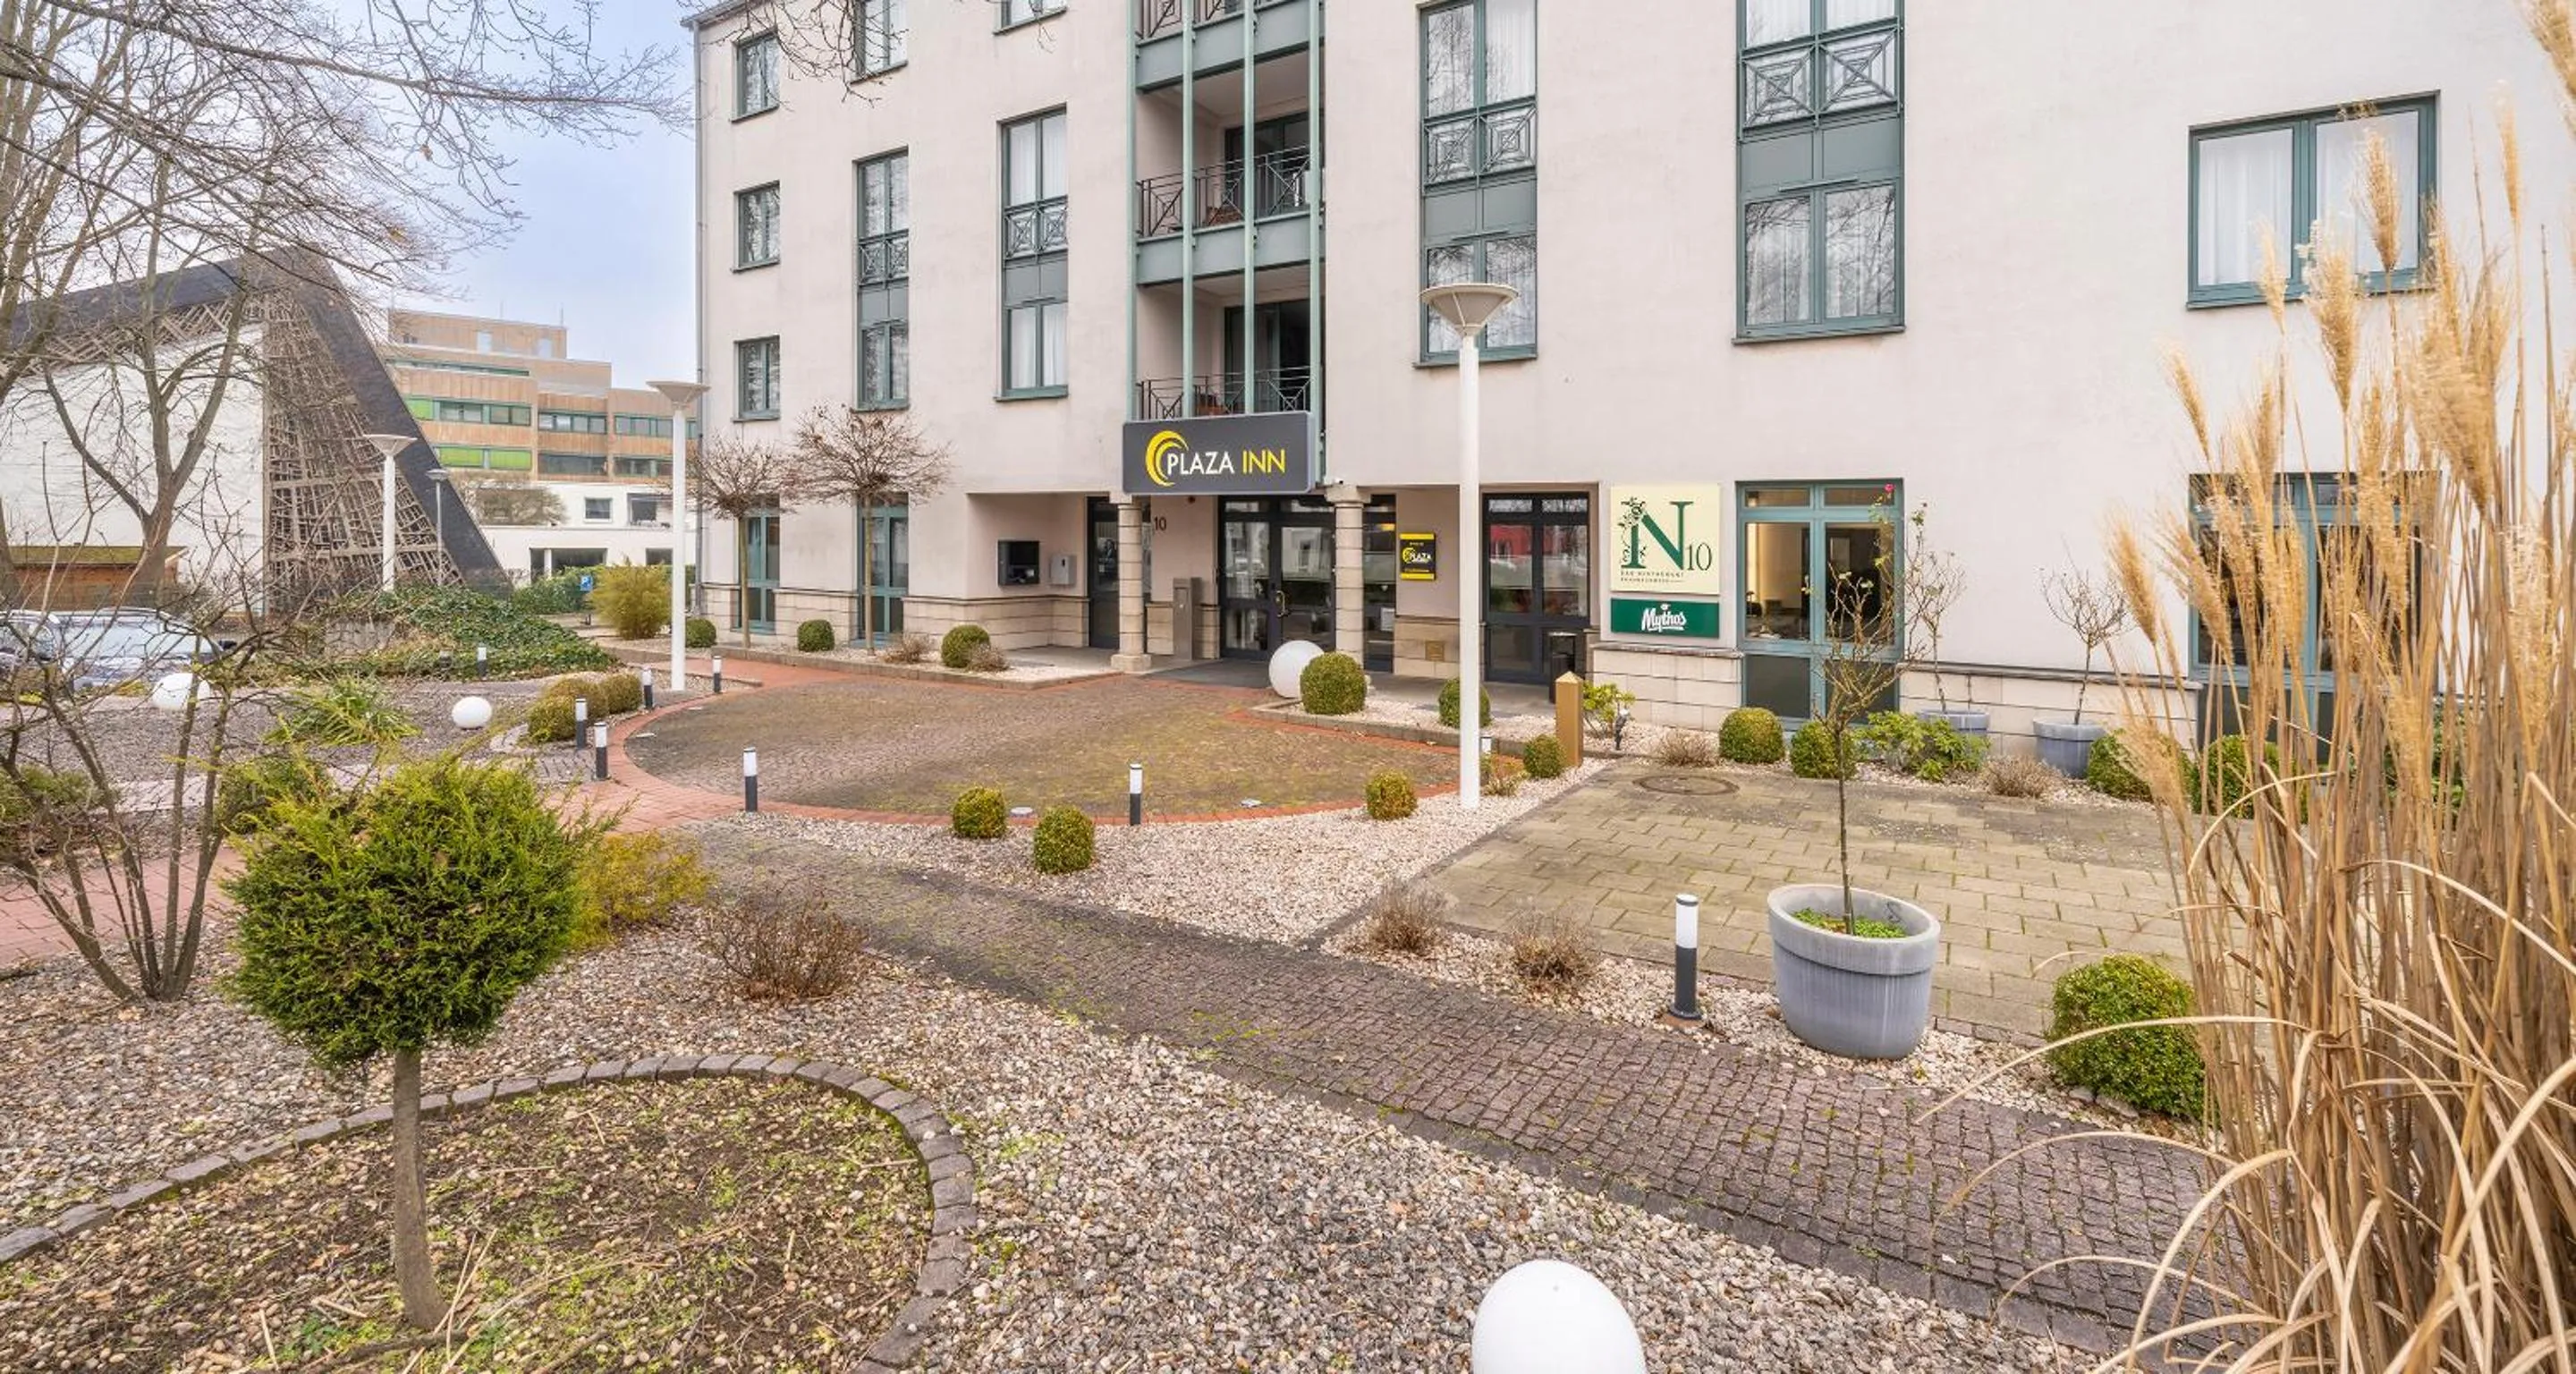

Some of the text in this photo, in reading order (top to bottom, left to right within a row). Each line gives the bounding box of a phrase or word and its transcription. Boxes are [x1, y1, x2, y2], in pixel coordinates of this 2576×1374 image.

[1166, 449, 1286, 475] PLAZA INN
[1155, 516, 1167, 531] 10
[1641, 606, 1687, 632] Mythos
